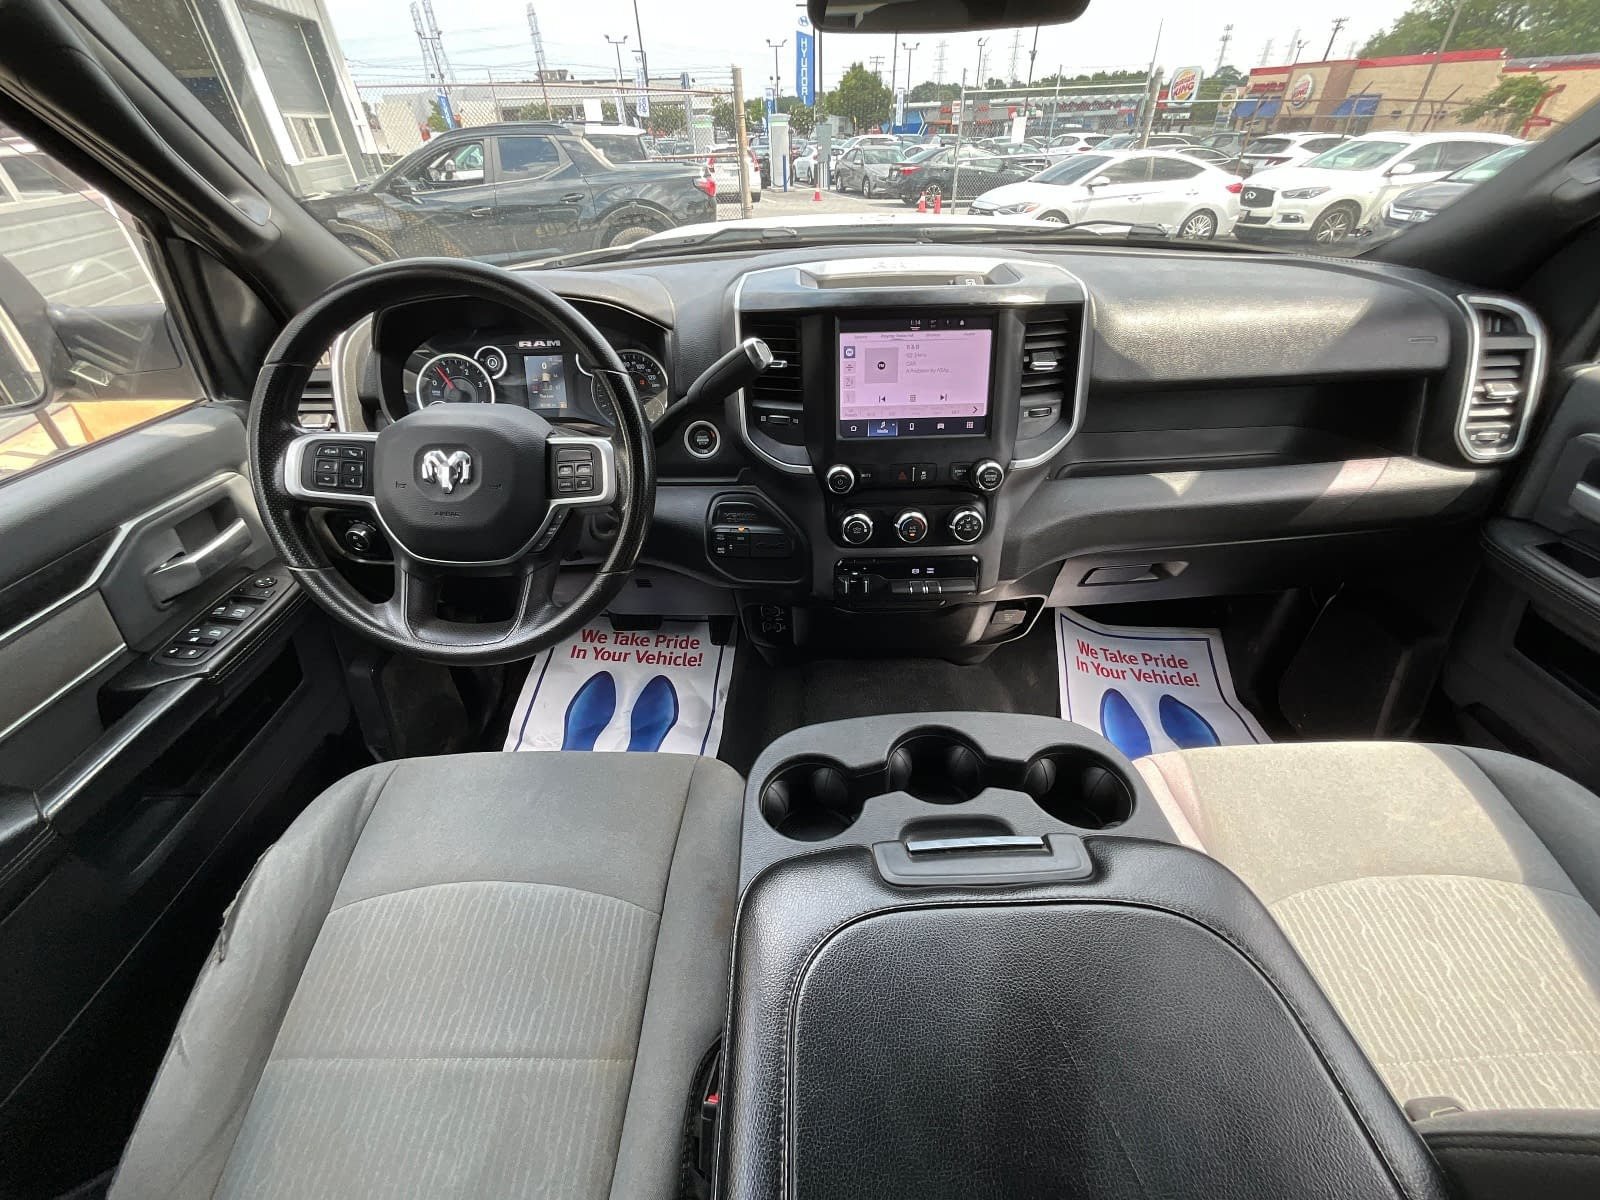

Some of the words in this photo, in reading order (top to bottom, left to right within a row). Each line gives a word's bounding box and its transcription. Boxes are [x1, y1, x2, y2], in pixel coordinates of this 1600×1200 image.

[1173, 81, 1195, 97] KING
[518, 339, 561, 348] RAM
[581, 629, 608, 644] We
[613, 631, 650, 647] Take
[654, 634, 700, 650] Pride
[570, 645, 587, 660] In
[593, 646, 631, 662] Your
[636, 650, 703, 667] Vehicle!
[1076, 639, 1099, 660] We
[1099, 647, 1140, 665] Take
[1141, 653, 1189, 669] Pride
[1076, 655, 1089, 673] In
[1091, 660, 1127, 681] Your
[1130, 667, 1200, 687] Vehicle!
